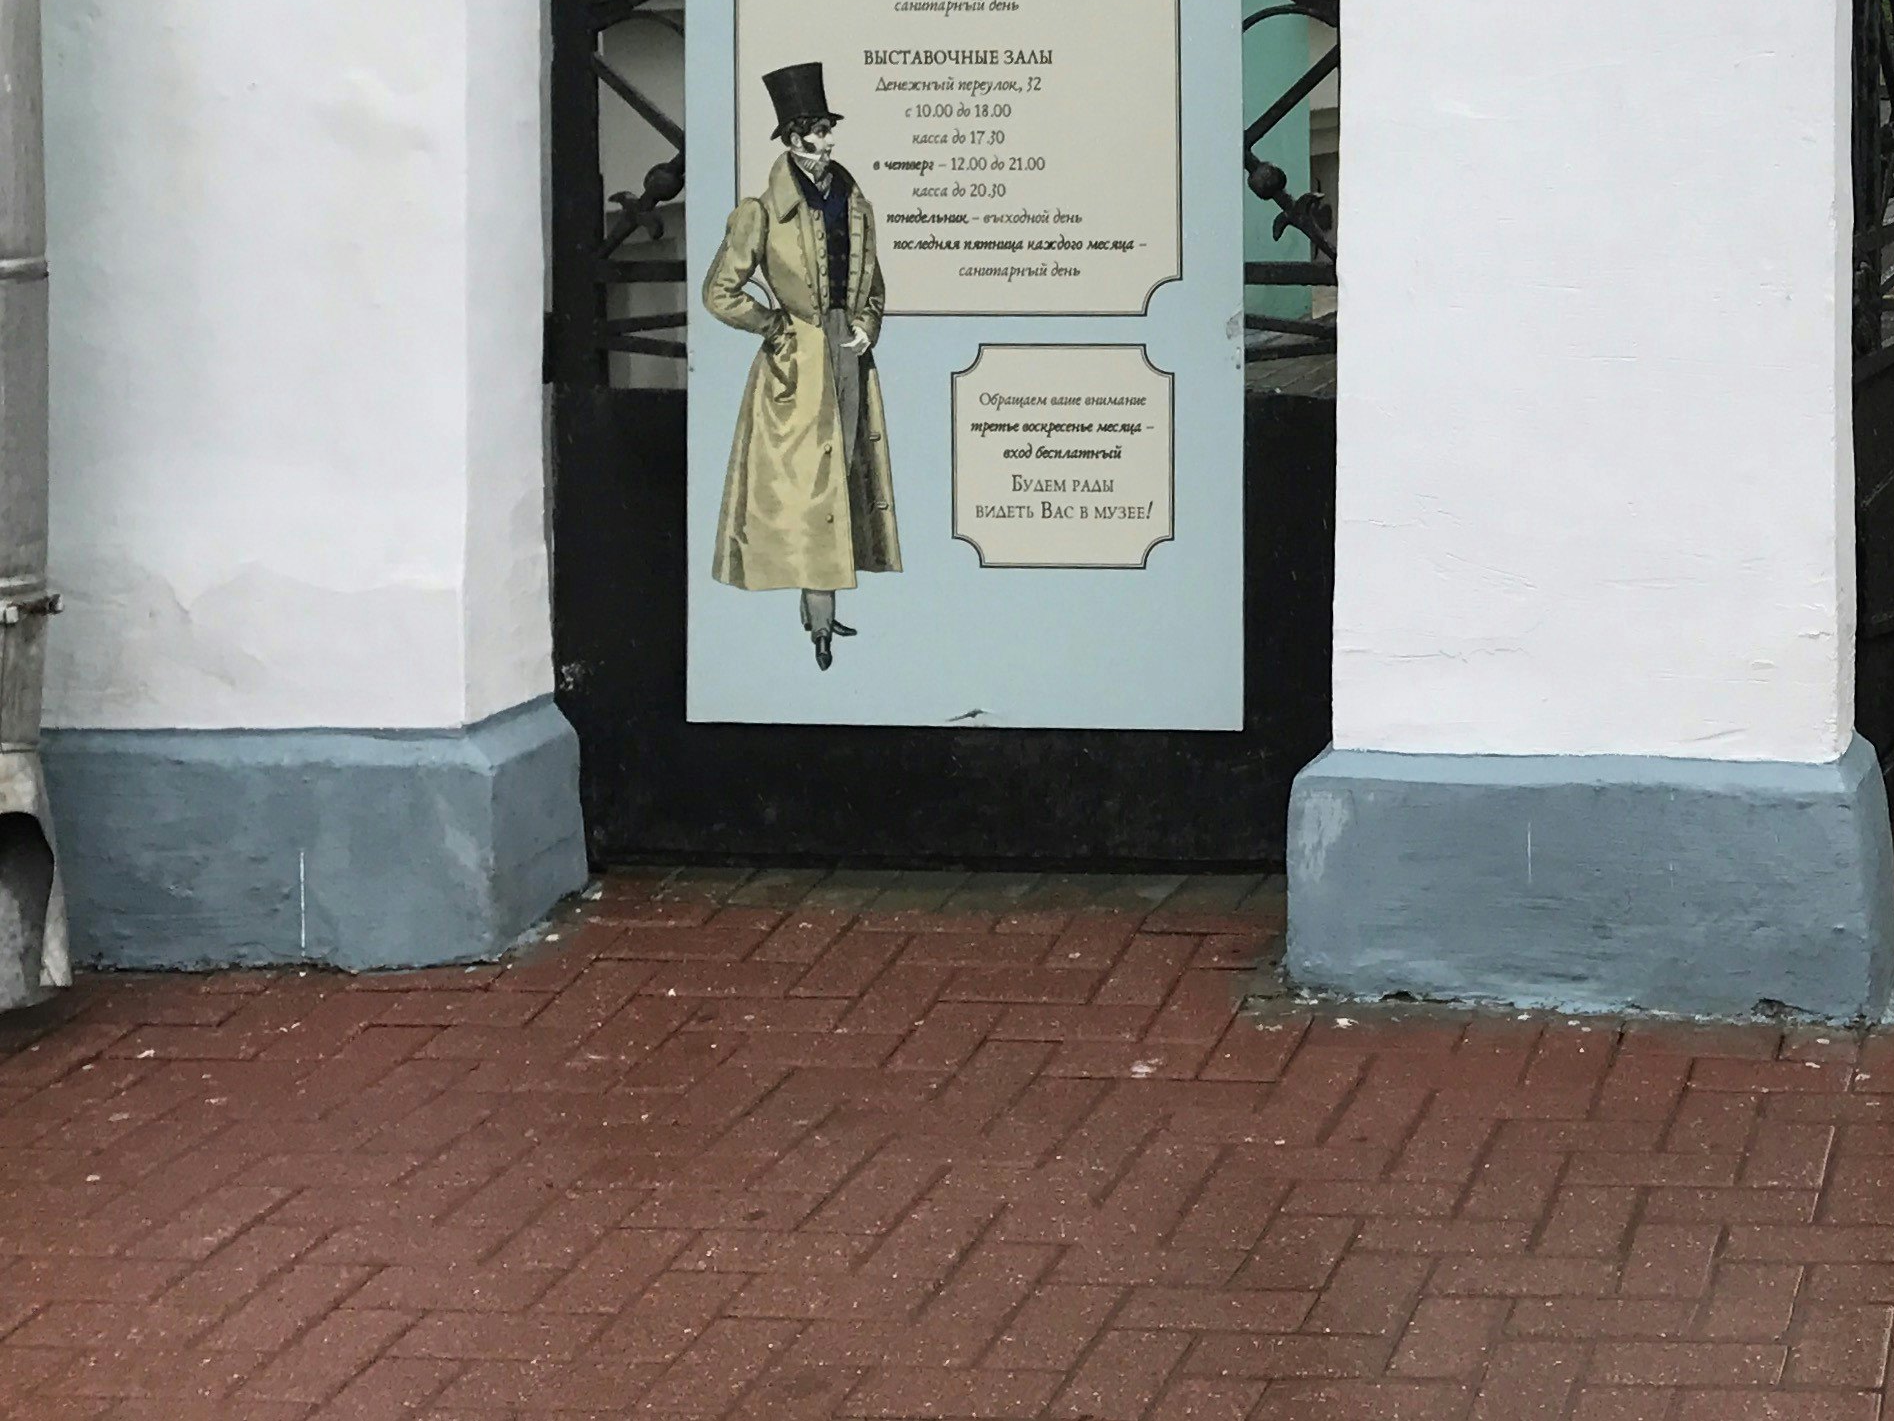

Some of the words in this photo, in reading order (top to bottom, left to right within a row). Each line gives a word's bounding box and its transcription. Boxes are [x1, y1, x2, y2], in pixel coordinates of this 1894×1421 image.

[863, 49, 999, 66] ВЫСТАВОЧНЫЕ
[1003, 49, 1053, 65] ЗАЛЫ
[875, 76, 954, 92] Денежный
[958, 79, 1023, 97] переулок,
[1027, 76, 1042, 92] 32
[916, 103, 953, 118] 10.00
[956, 101, 971, 118] до
[974, 103, 1012, 118] 18.00
[912, 132, 948, 144] касса
[951, 128, 966, 145] до
[969, 130, 1005, 145] 17.30
[884, 160, 934, 176] четверг
[950, 156, 987, 171] 12.00
[991, 154, 1005, 171] до
[1008, 156, 1046, 171] 21.00
[912, 185, 948, 197] касса
[951, 180, 966, 197] до
[969, 183, 1006, 198] 20.30
[886, 207, 970, 224] понедельник
[983, 207, 1049, 224] выходной
[1053, 206, 1083, 224] день
[893, 233, 960, 250] последняя
[963, 239, 1024, 252] пятница
[1027, 233, 1083, 250] каждого
[1086, 239, 1135, 253] месяца
[958, 262, 1047, 282] санитарный
[1051, 261, 1081, 277] день
[979, 392, 1048, 410] Обращаем
[1050, 394, 1081, 406] ваше
[1084, 394, 1147, 407] внимание
[970, 421, 1019, 437] третье
[1022, 420, 1093, 437] воскресенье
[1096, 420, 1142, 435] месяца
[1003, 442, 1033, 460] вход
[1035, 444, 1122, 460] бесплатный
